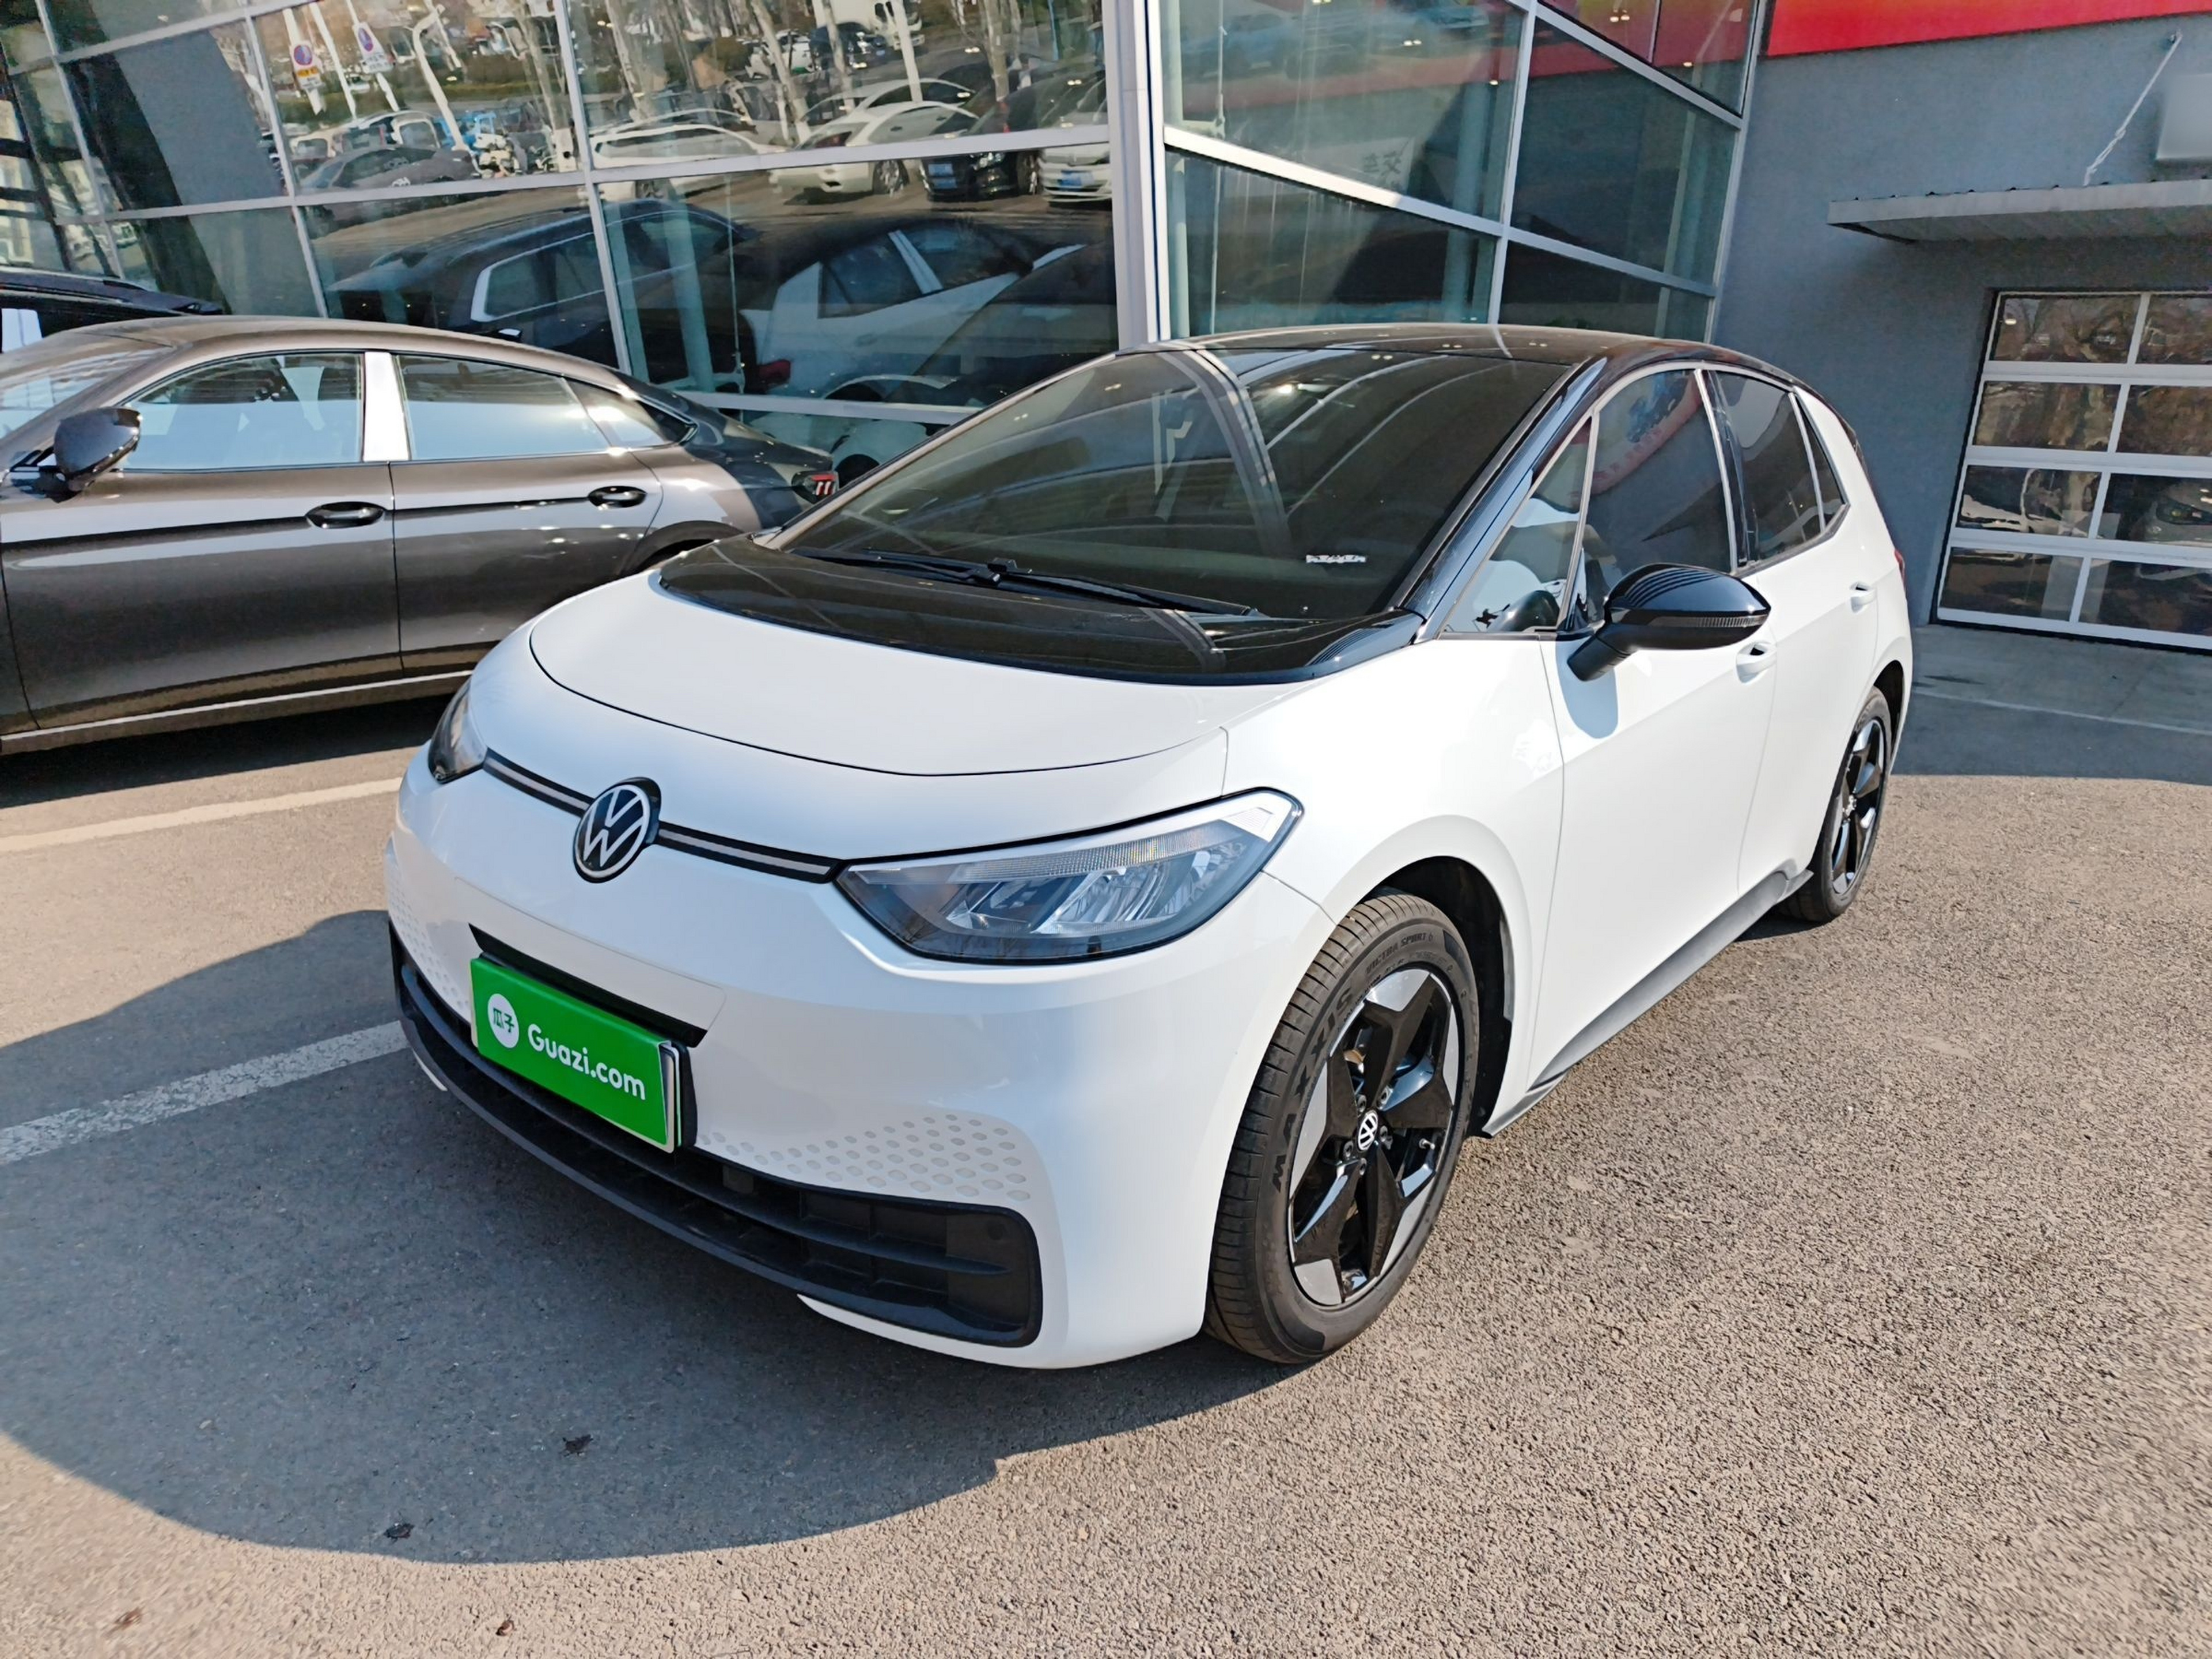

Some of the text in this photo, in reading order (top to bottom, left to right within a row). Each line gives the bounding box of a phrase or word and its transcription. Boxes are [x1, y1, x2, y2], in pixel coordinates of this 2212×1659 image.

[493, 1007, 515, 1033] 瓜子
[528, 1024, 646, 1100] Guazi.com
[1271, 987, 1351, 1194] MAXXIS
